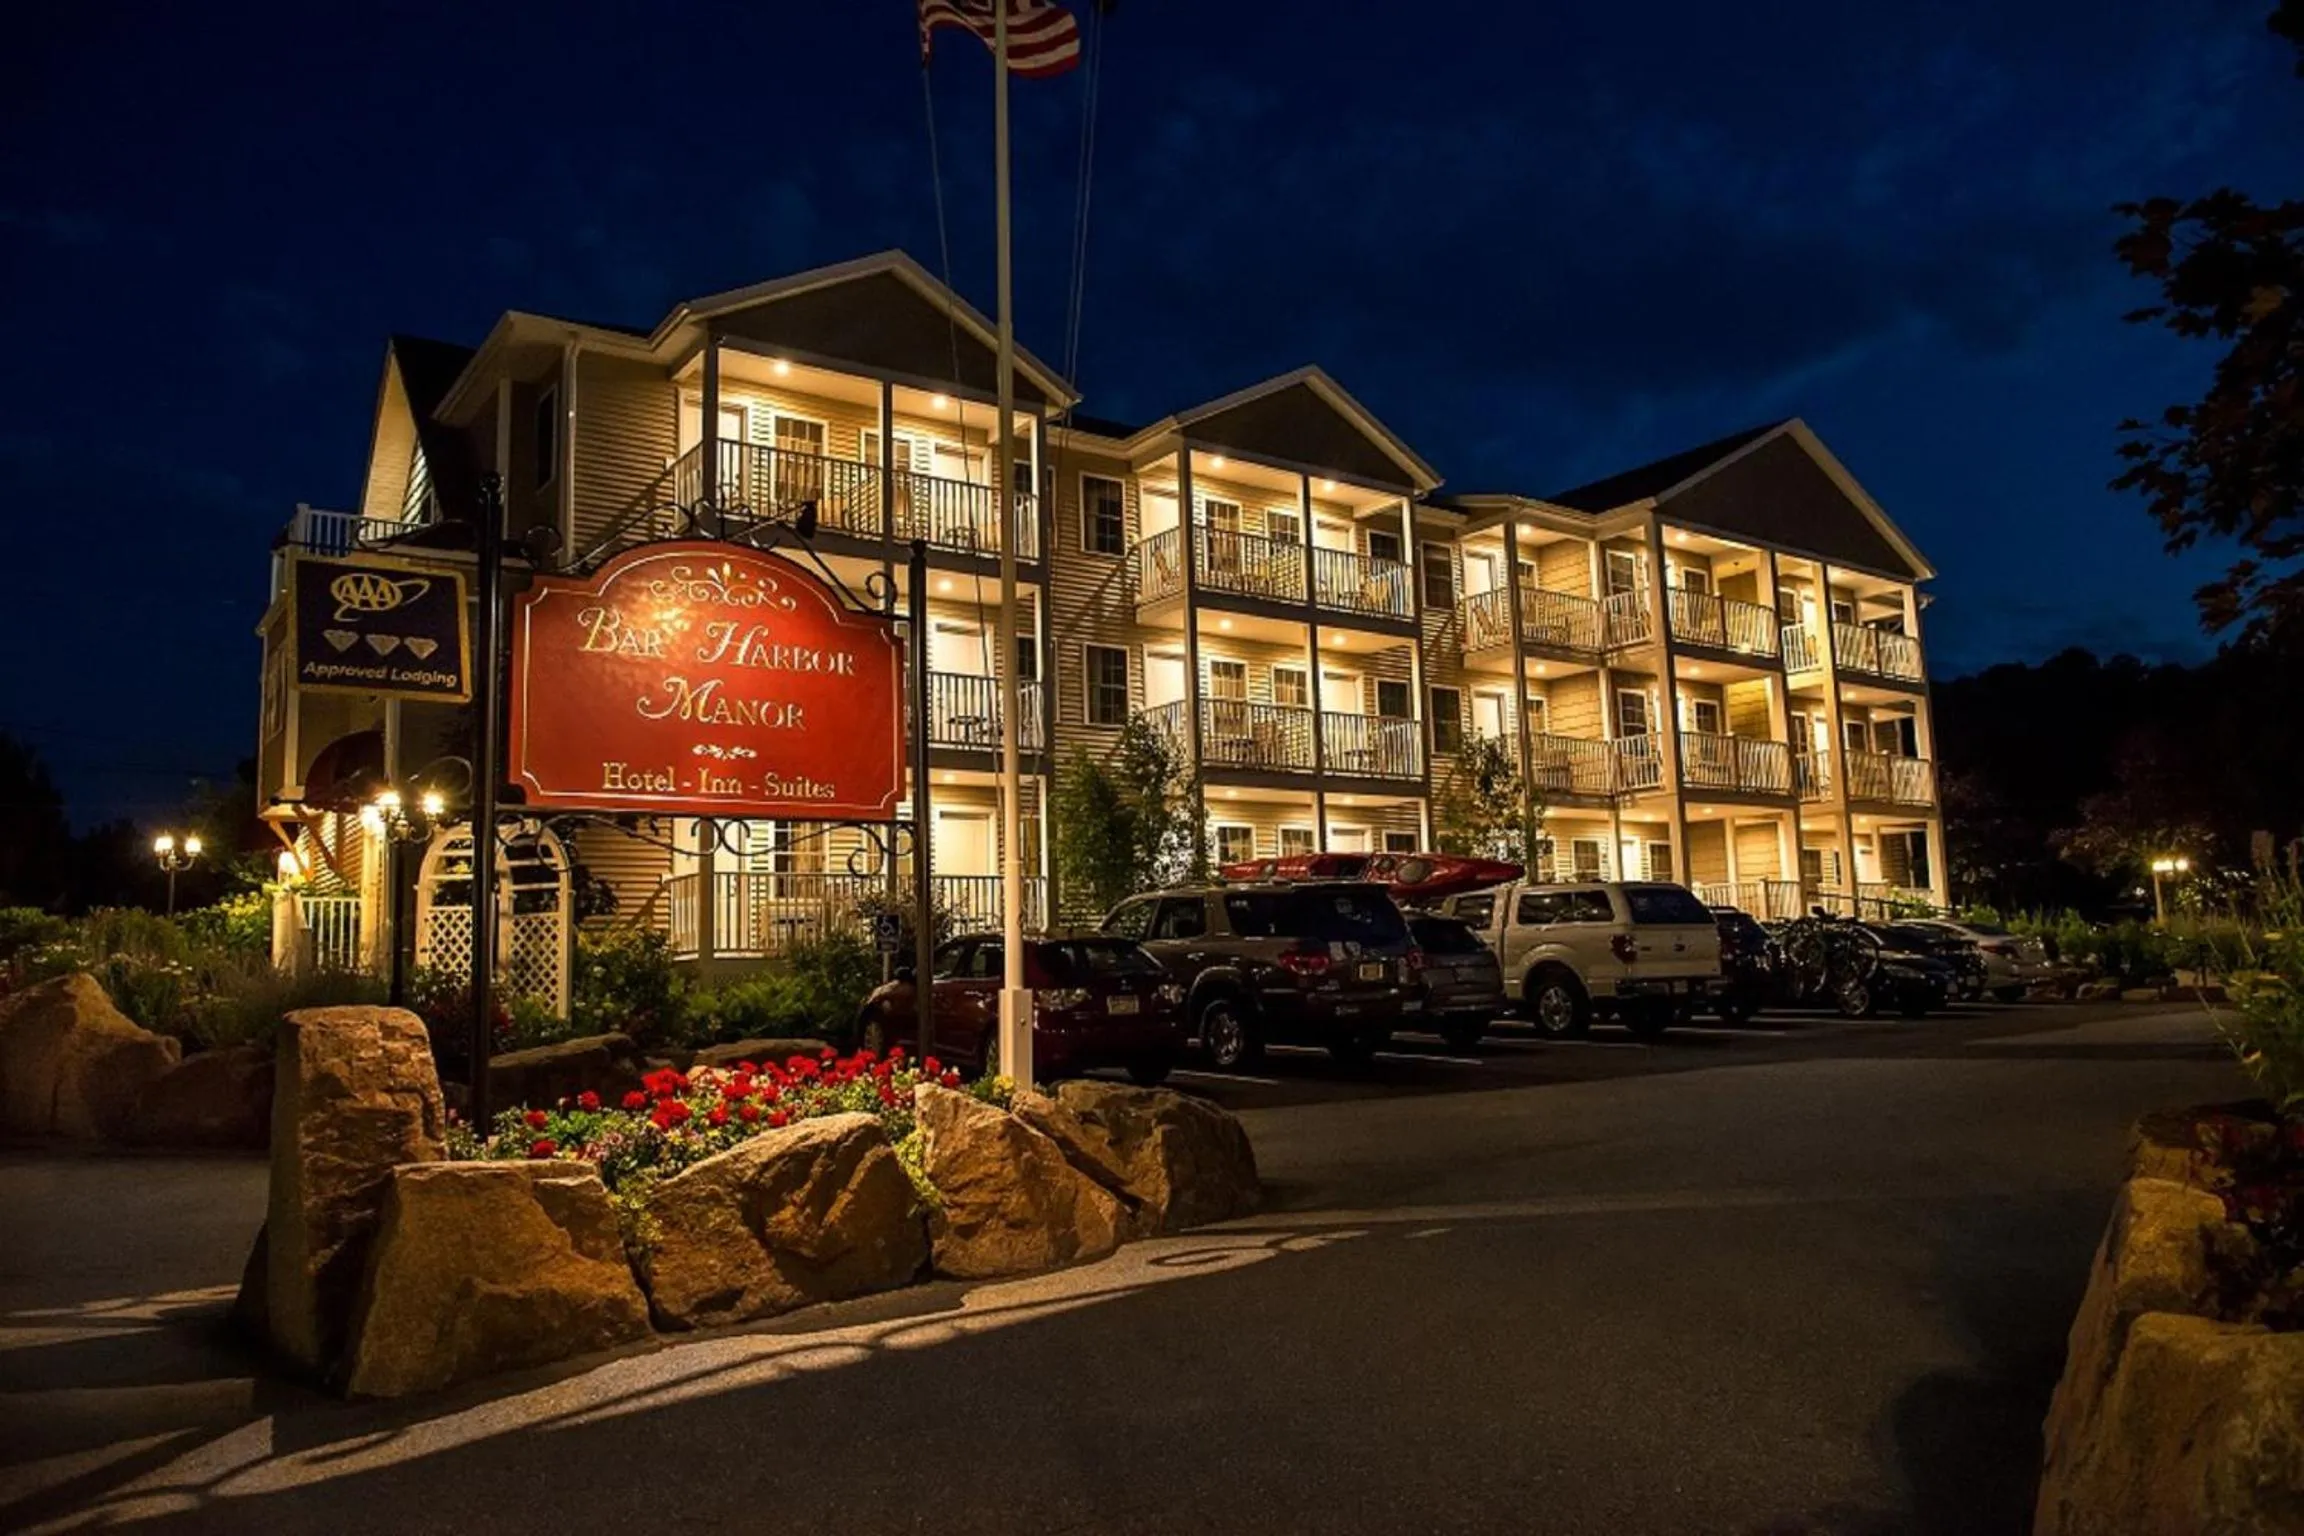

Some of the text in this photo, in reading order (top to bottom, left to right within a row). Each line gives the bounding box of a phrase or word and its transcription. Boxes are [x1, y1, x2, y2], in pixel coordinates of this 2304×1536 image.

[577, 605, 855, 677] BAR HARBOR
[303, 661, 457, 687] Approved Lodging
[636, 675, 805, 730] MANOR
[602, 762, 677, 792] Hotel
[698, 767, 743, 795] Inn
[765, 771, 836, 799] Suites
